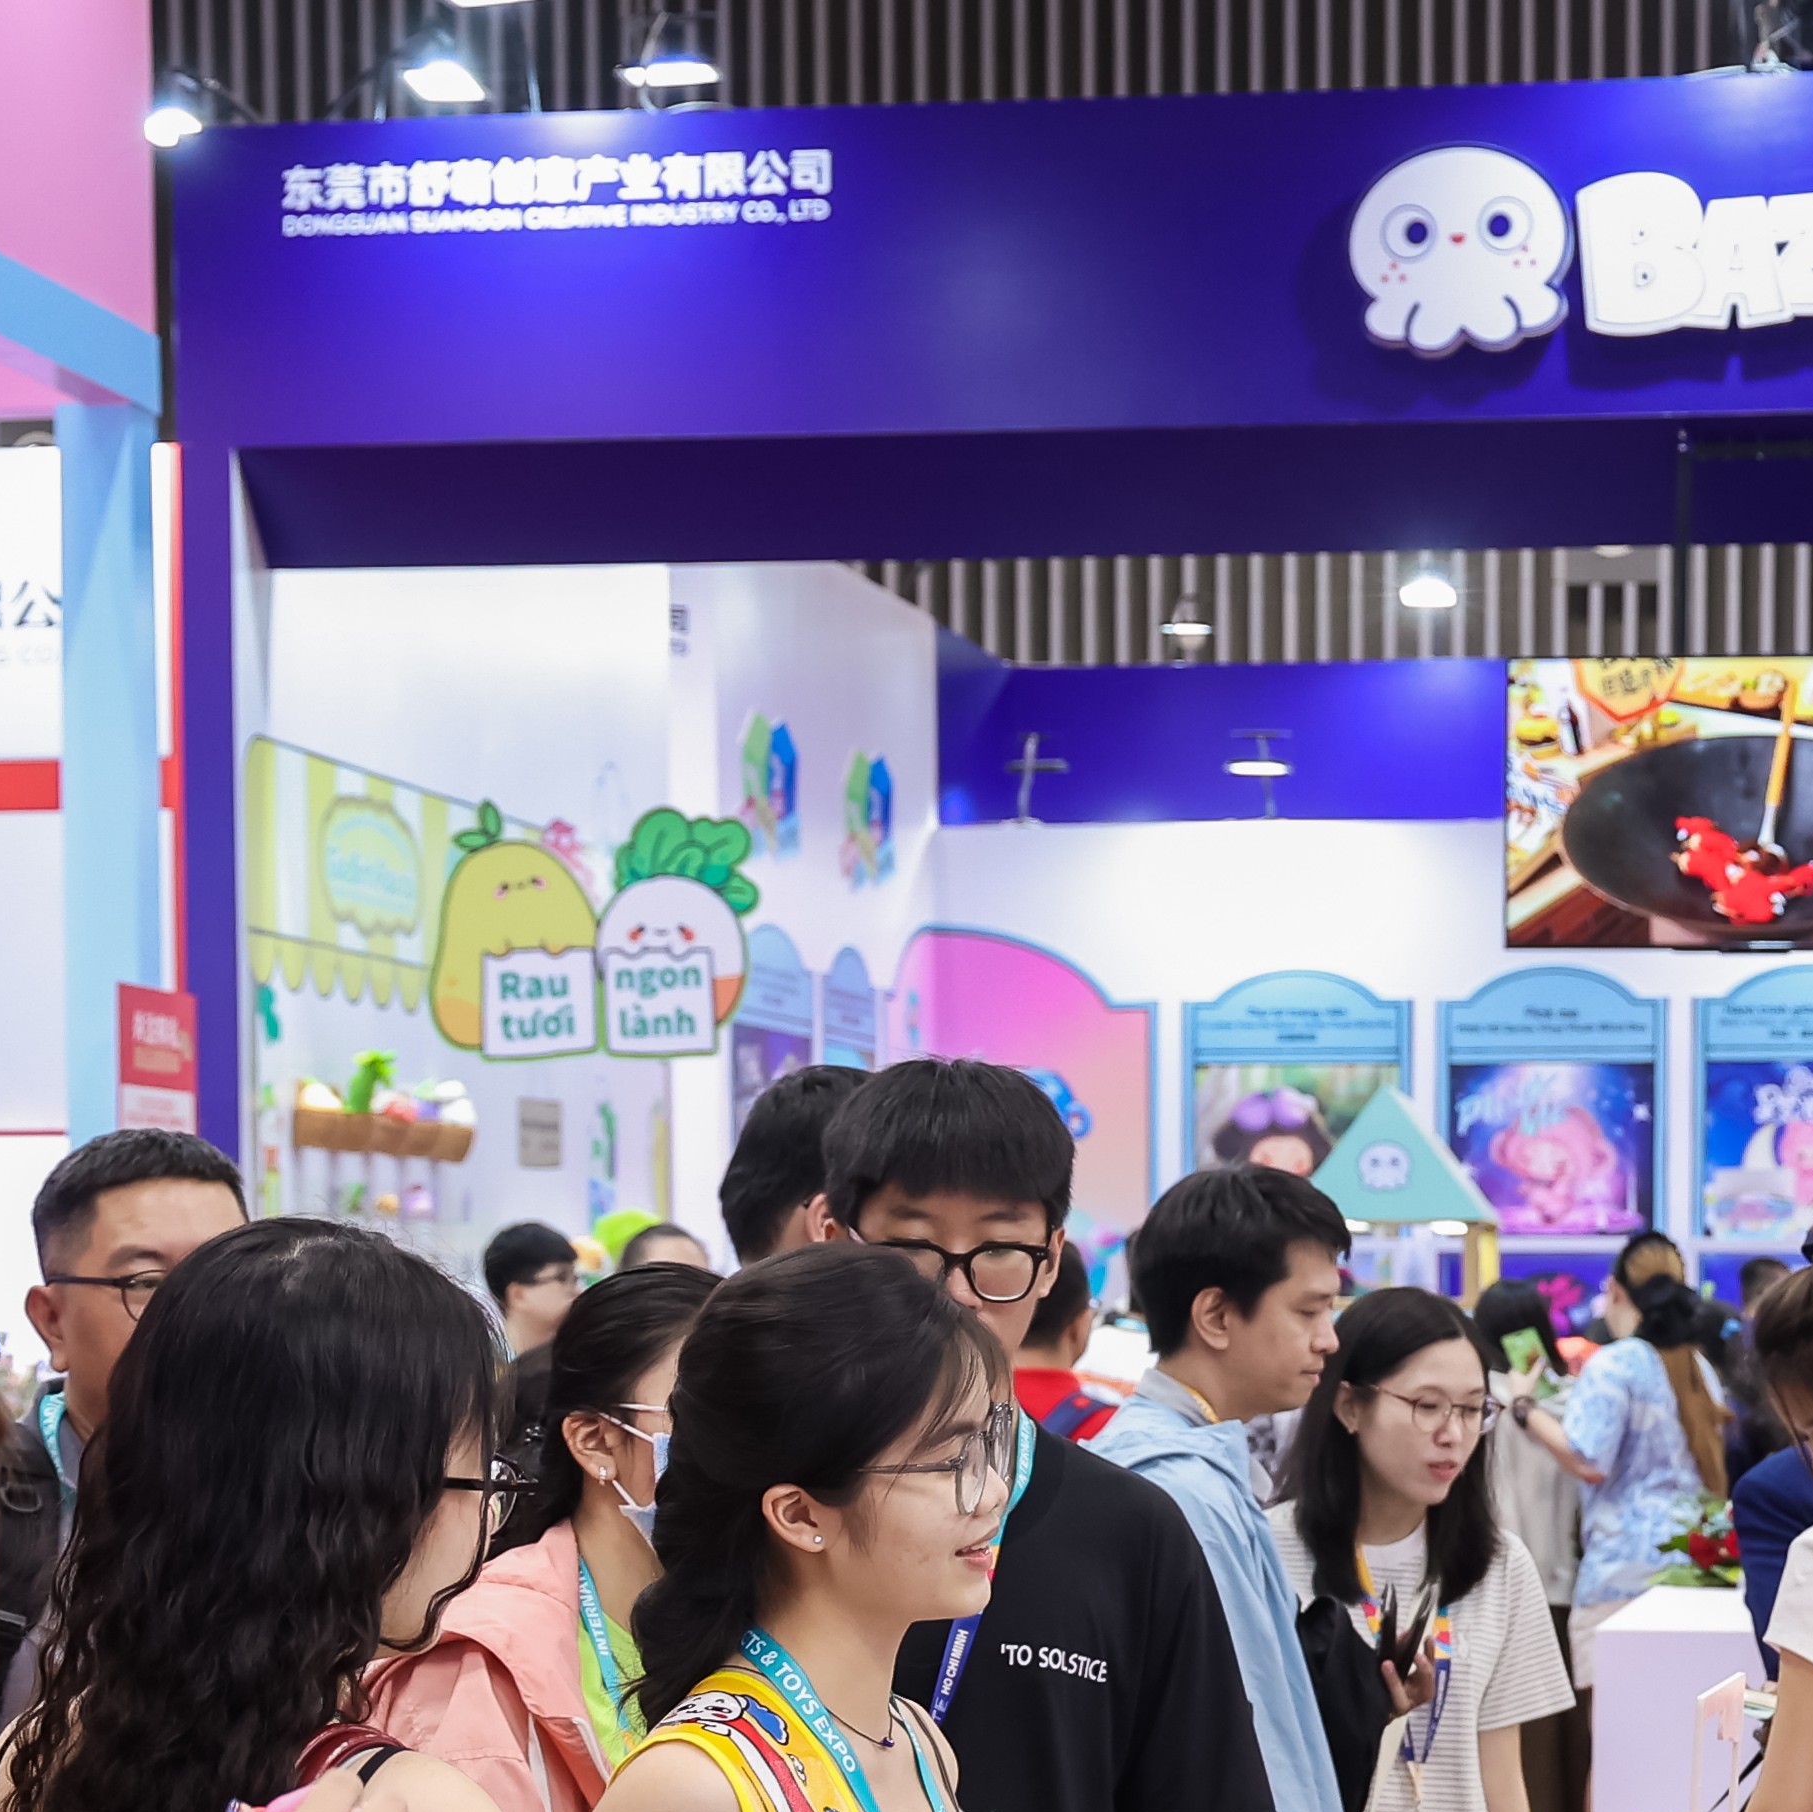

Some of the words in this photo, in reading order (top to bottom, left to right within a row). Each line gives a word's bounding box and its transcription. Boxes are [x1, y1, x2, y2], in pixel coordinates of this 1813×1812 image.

[500, 971, 569, 1001] Rau
[615, 963, 702, 995] ngon
[619, 1004, 696, 1038] lành
[1038, 1646, 1108, 1684] SOLSTICE
[760, 1651, 779, 1667] &
[774, 1662, 820, 1715] TOYS
[813, 1716, 856, 1773] EXPO
